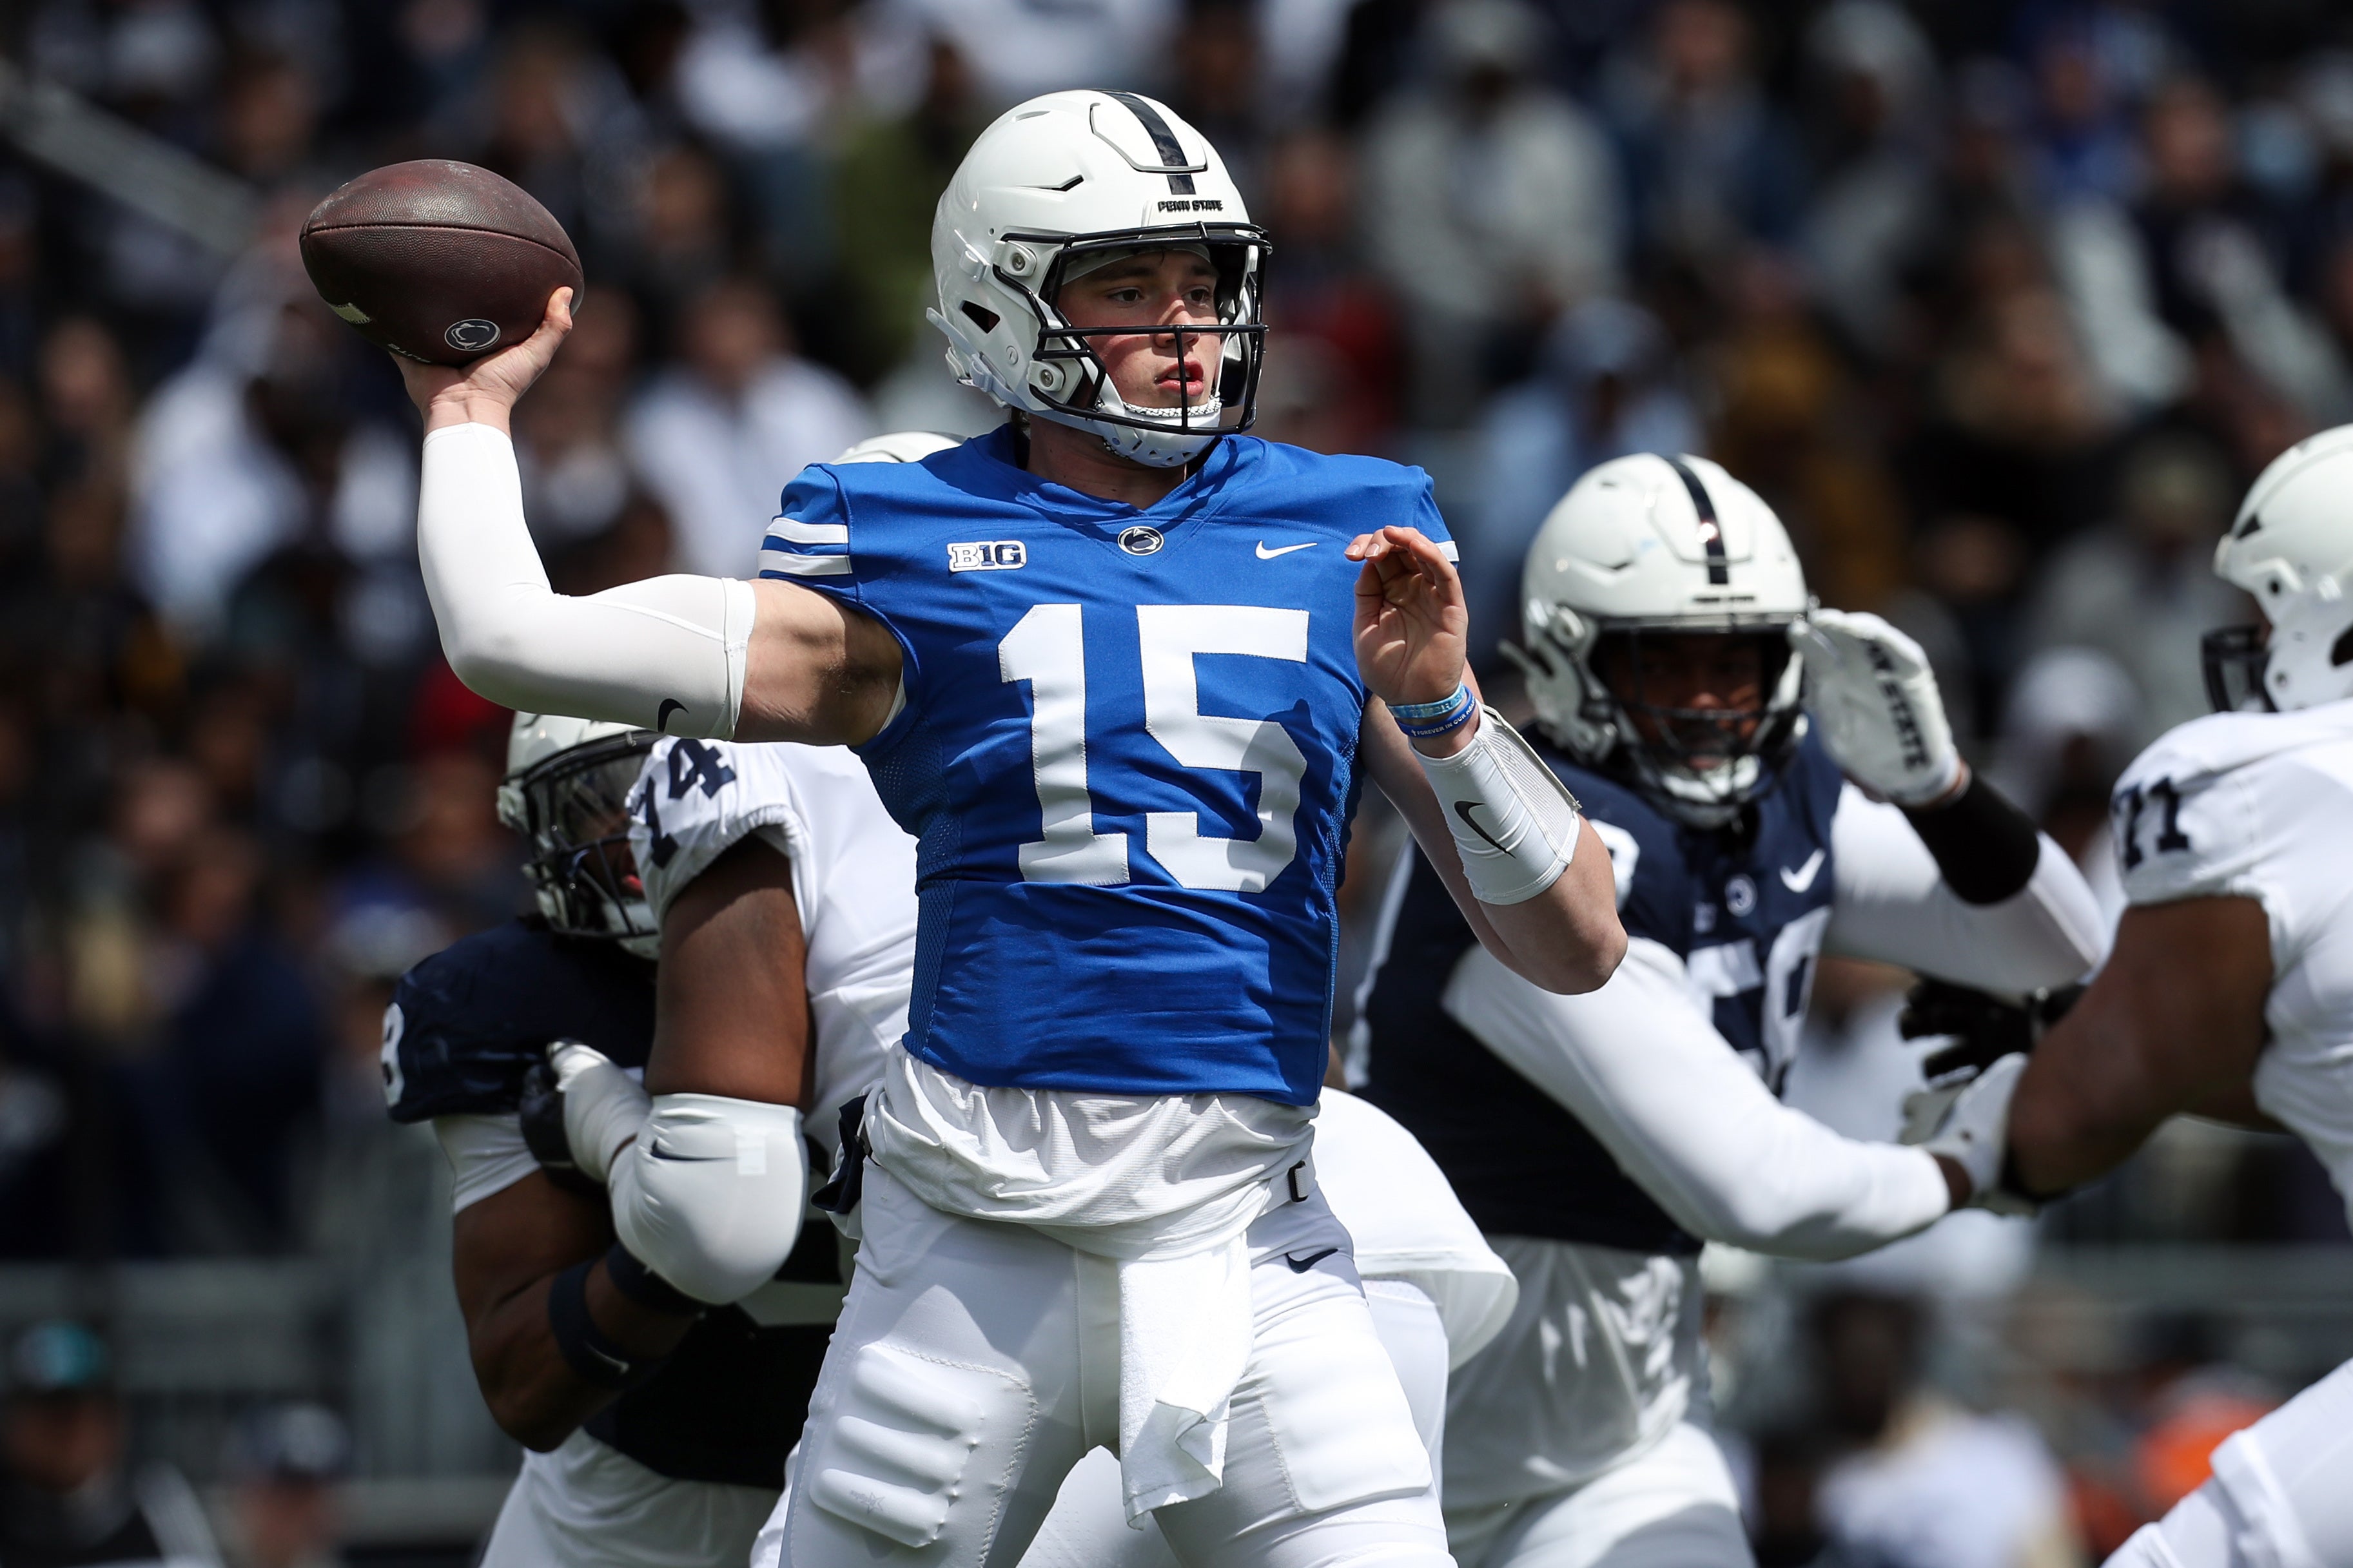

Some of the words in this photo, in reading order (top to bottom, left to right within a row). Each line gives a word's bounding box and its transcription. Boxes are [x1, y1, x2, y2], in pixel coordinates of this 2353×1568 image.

[1158, 200, 1190, 213] PENN
[1192, 200, 1223, 211] STATE
[998, 603, 1310, 893] 15
[1417, 726, 1444, 735] FOREVER
[1453, 713, 1466, 724] OUR
[626, 738, 737, 868] 74
